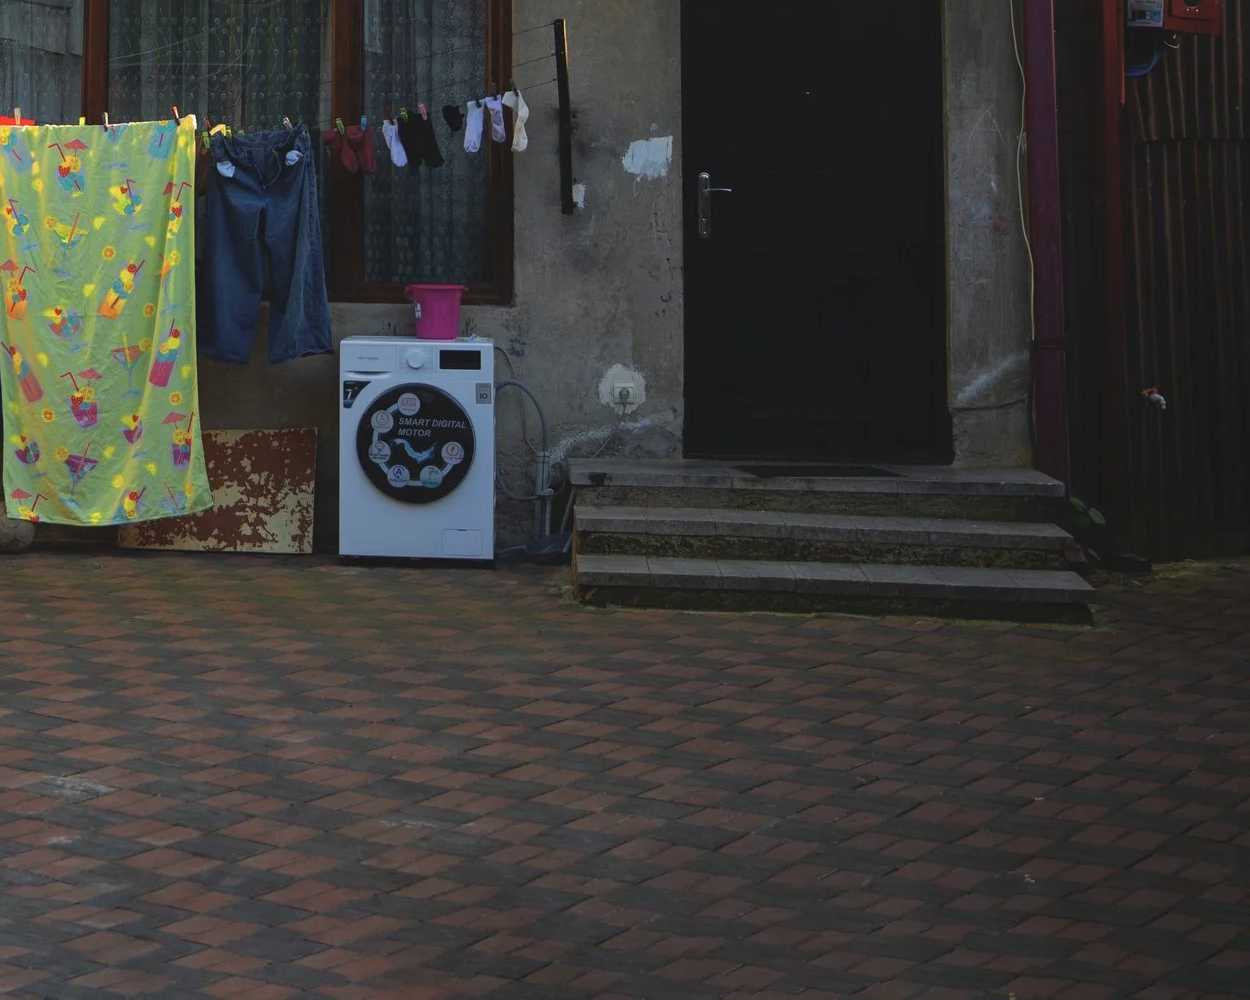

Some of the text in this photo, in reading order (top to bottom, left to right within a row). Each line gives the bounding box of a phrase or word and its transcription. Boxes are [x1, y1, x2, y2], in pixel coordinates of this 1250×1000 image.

[398, 417, 430, 427] SMART
[432, 419, 466, 429] DIGITAL
[398, 428, 431, 437] MOTOR
